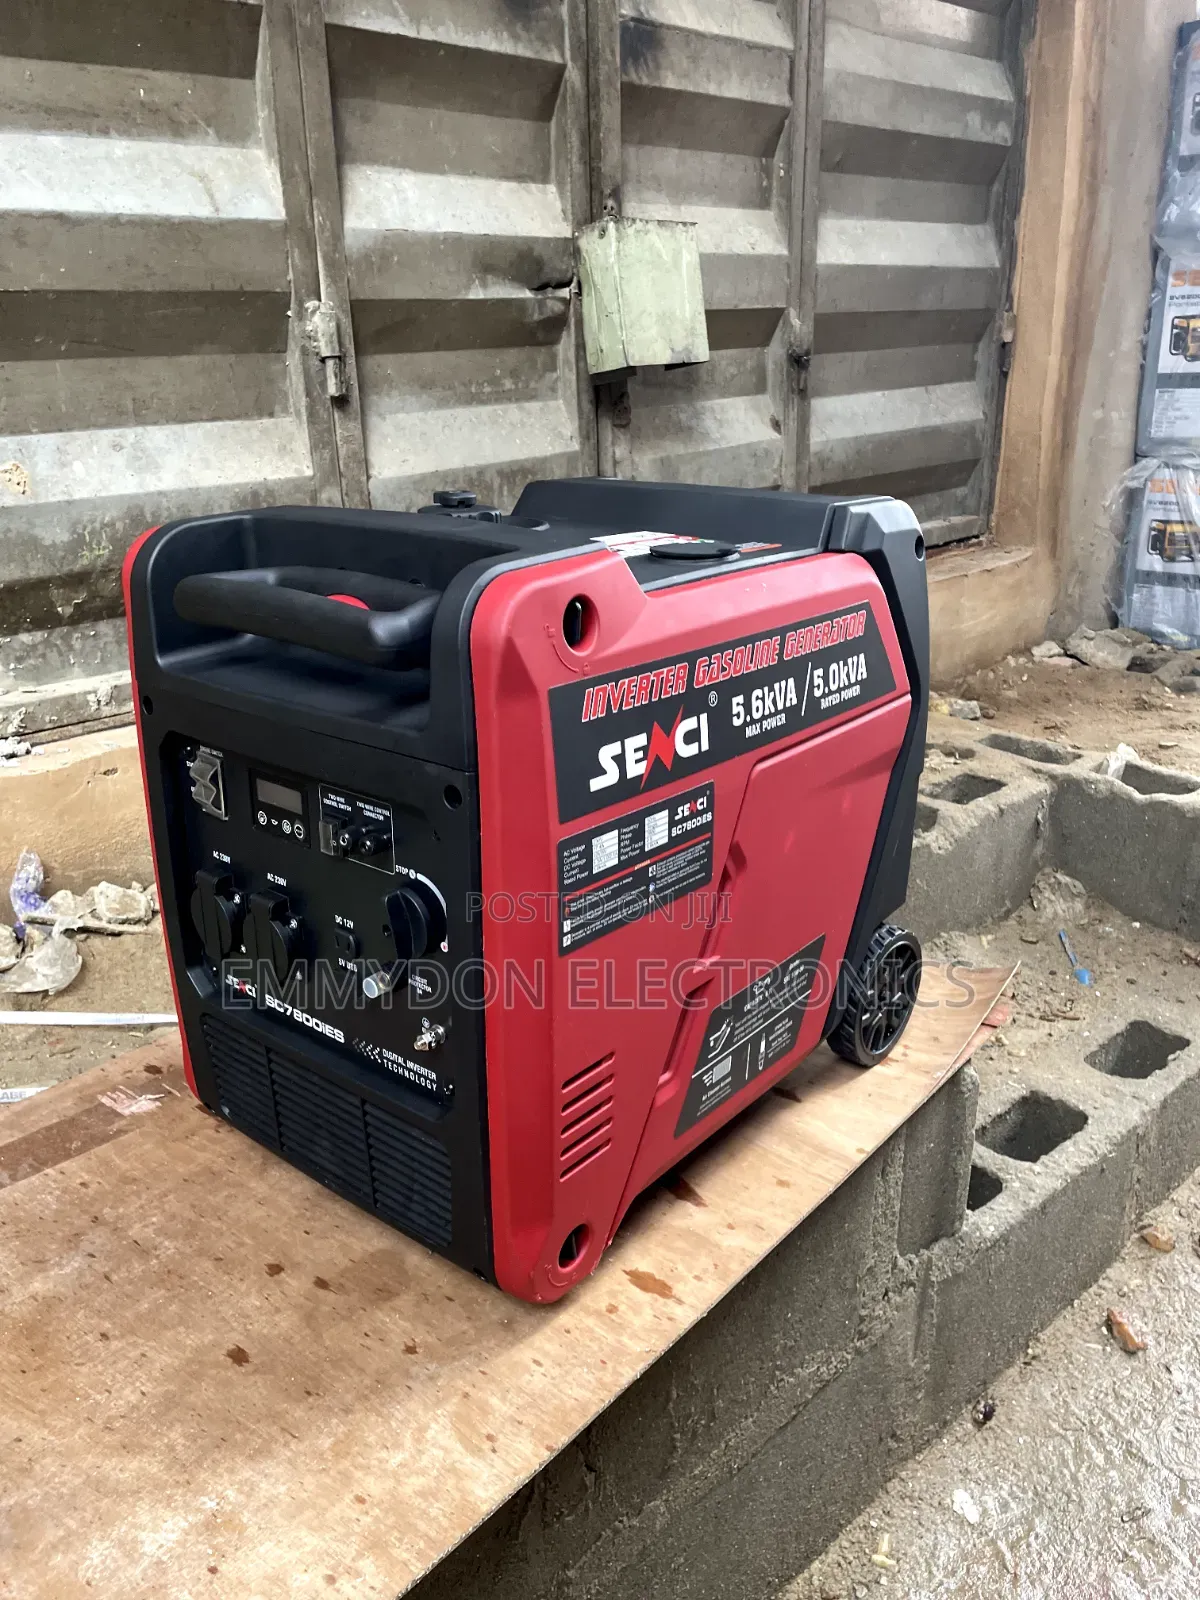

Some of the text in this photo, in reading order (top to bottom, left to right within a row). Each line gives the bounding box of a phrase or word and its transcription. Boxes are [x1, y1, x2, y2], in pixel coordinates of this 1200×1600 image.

[582, 610, 866, 722] INVERTER GASOLINE GENERATOR
[820, 685, 861, 710] RATED POWER
[745, 714, 786, 739] MAX POWER
[589, 704, 710, 792] SENCI
[674, 796, 707, 820] SENCI
[395, 864, 409, 876] STOP
[334, 914, 354, 929] DC 12V
[264, 993, 346, 1044] SC7800iES
[382, 1049, 437, 1082] DIGITAL INVERTER
[383, 1059, 438, 1092] TECHNOLOGY
